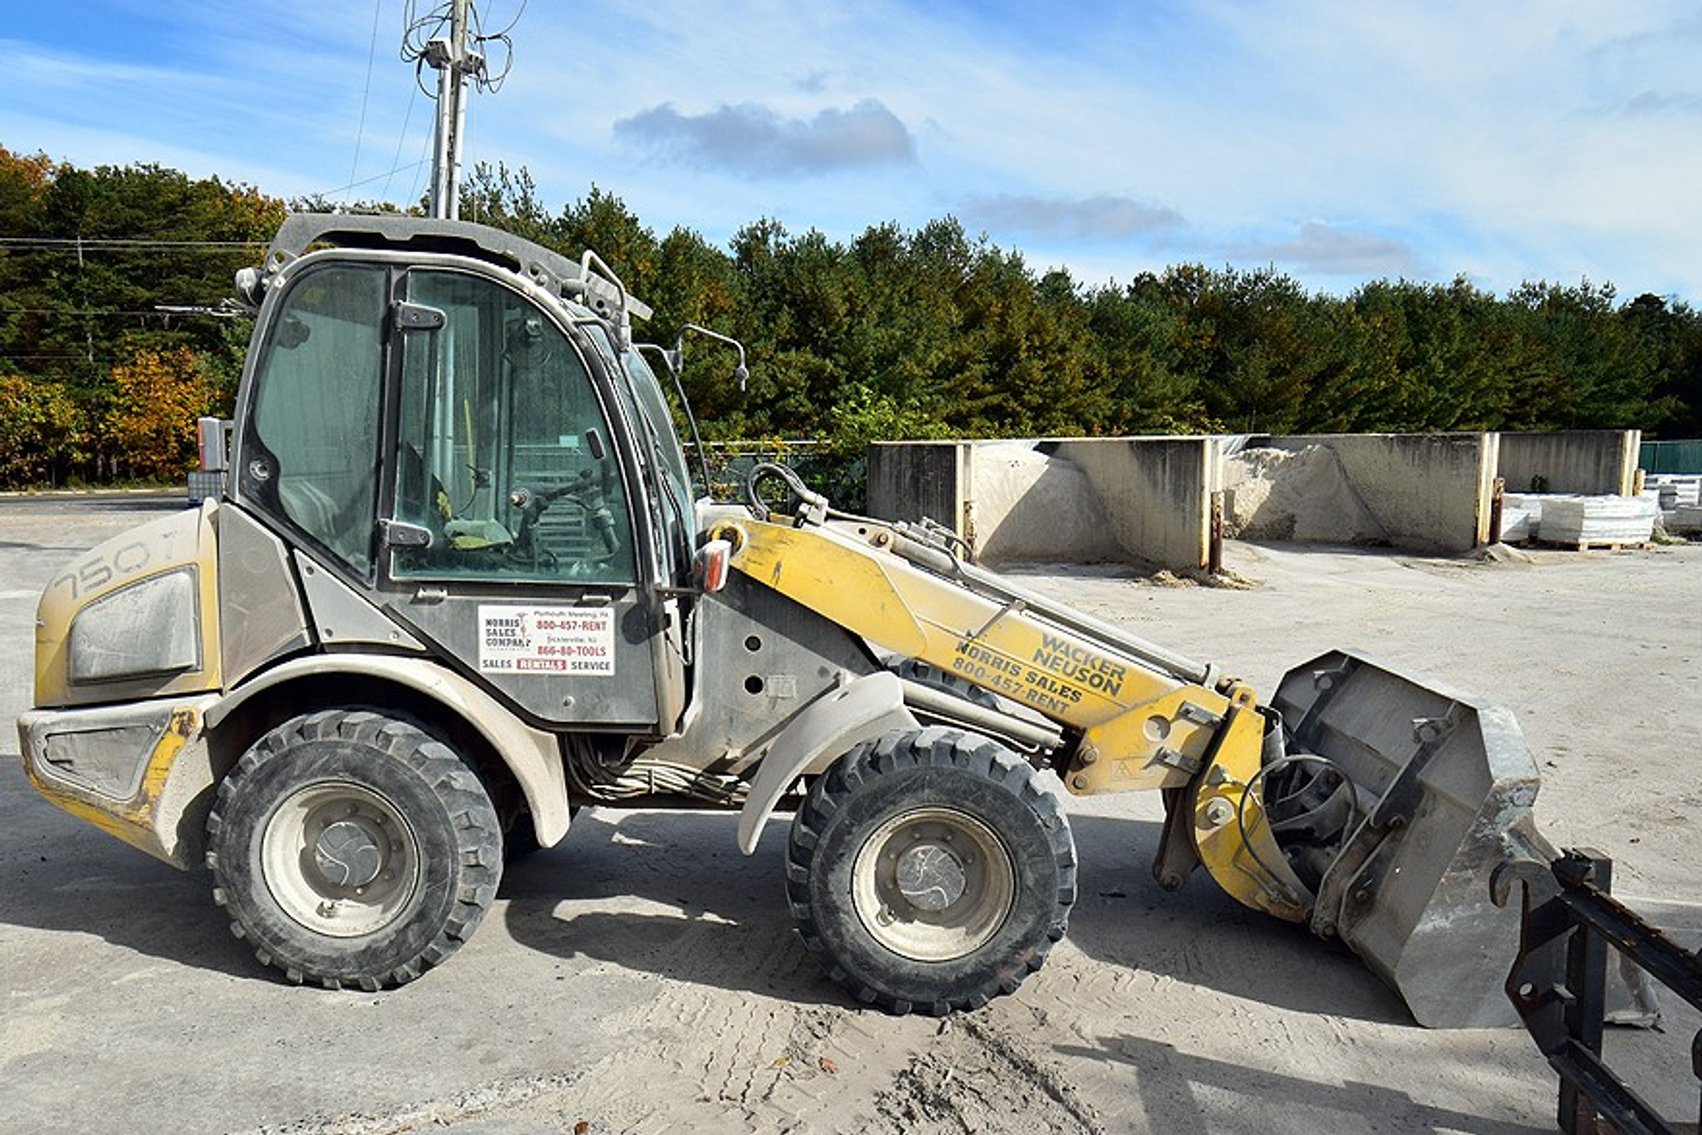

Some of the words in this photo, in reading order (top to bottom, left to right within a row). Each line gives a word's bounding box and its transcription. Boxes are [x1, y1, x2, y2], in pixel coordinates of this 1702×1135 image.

[486, 619, 520, 627] NORRIS
[486, 629, 516, 637] SALES
[485, 638, 531, 647] COMPANY
[1041, 633, 1127, 681] WACKER
[483, 660, 512, 668] SALES
[518, 660, 567, 669] RENTALS
[571, 661, 610, 670] SERVICE
[955, 640, 1022, 676] NORRIS
[1025, 671, 1083, 702] SALES
[1032, 648, 1123, 696] NEUSON
